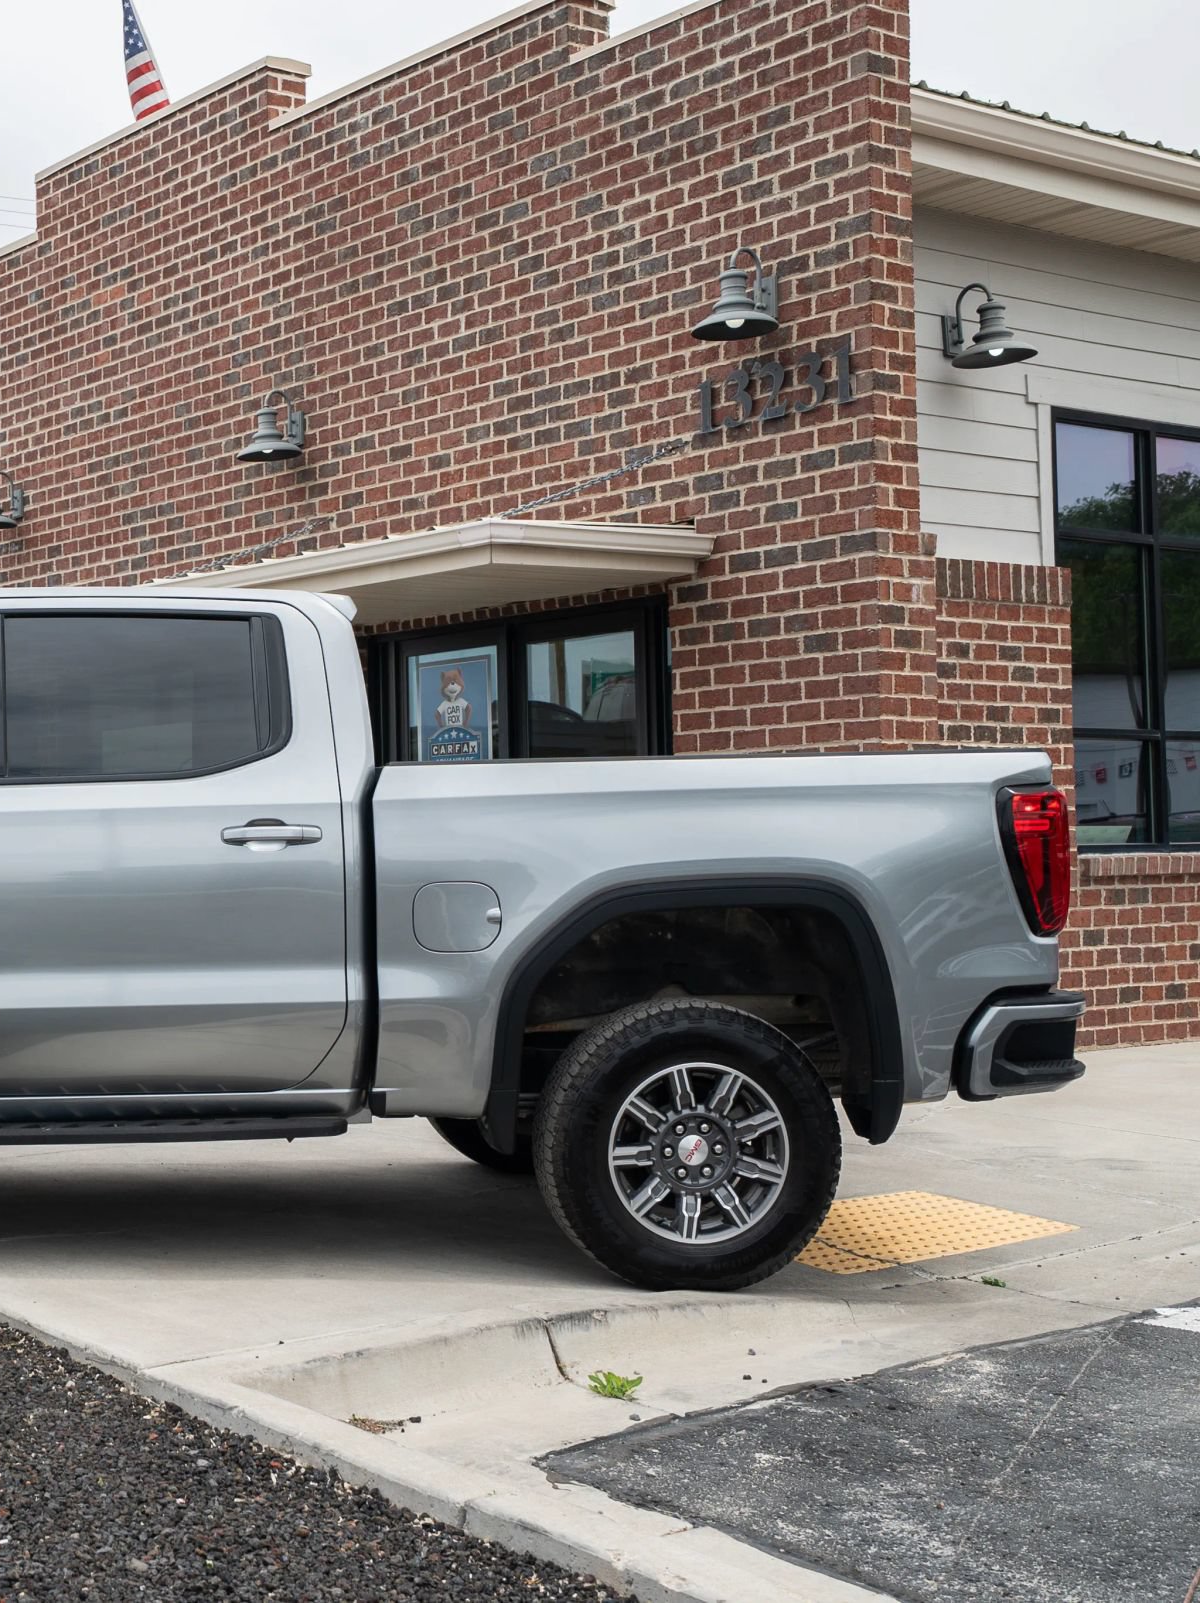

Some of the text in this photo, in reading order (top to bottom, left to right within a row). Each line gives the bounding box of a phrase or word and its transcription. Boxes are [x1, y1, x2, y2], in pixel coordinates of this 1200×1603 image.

[699, 338, 854, 433] 13231
[446, 706, 461, 716] CAR
[447, 715, 461, 724] FOX
[432, 743, 476, 755] CARFAX
[684, 1138, 703, 1163] GMC
